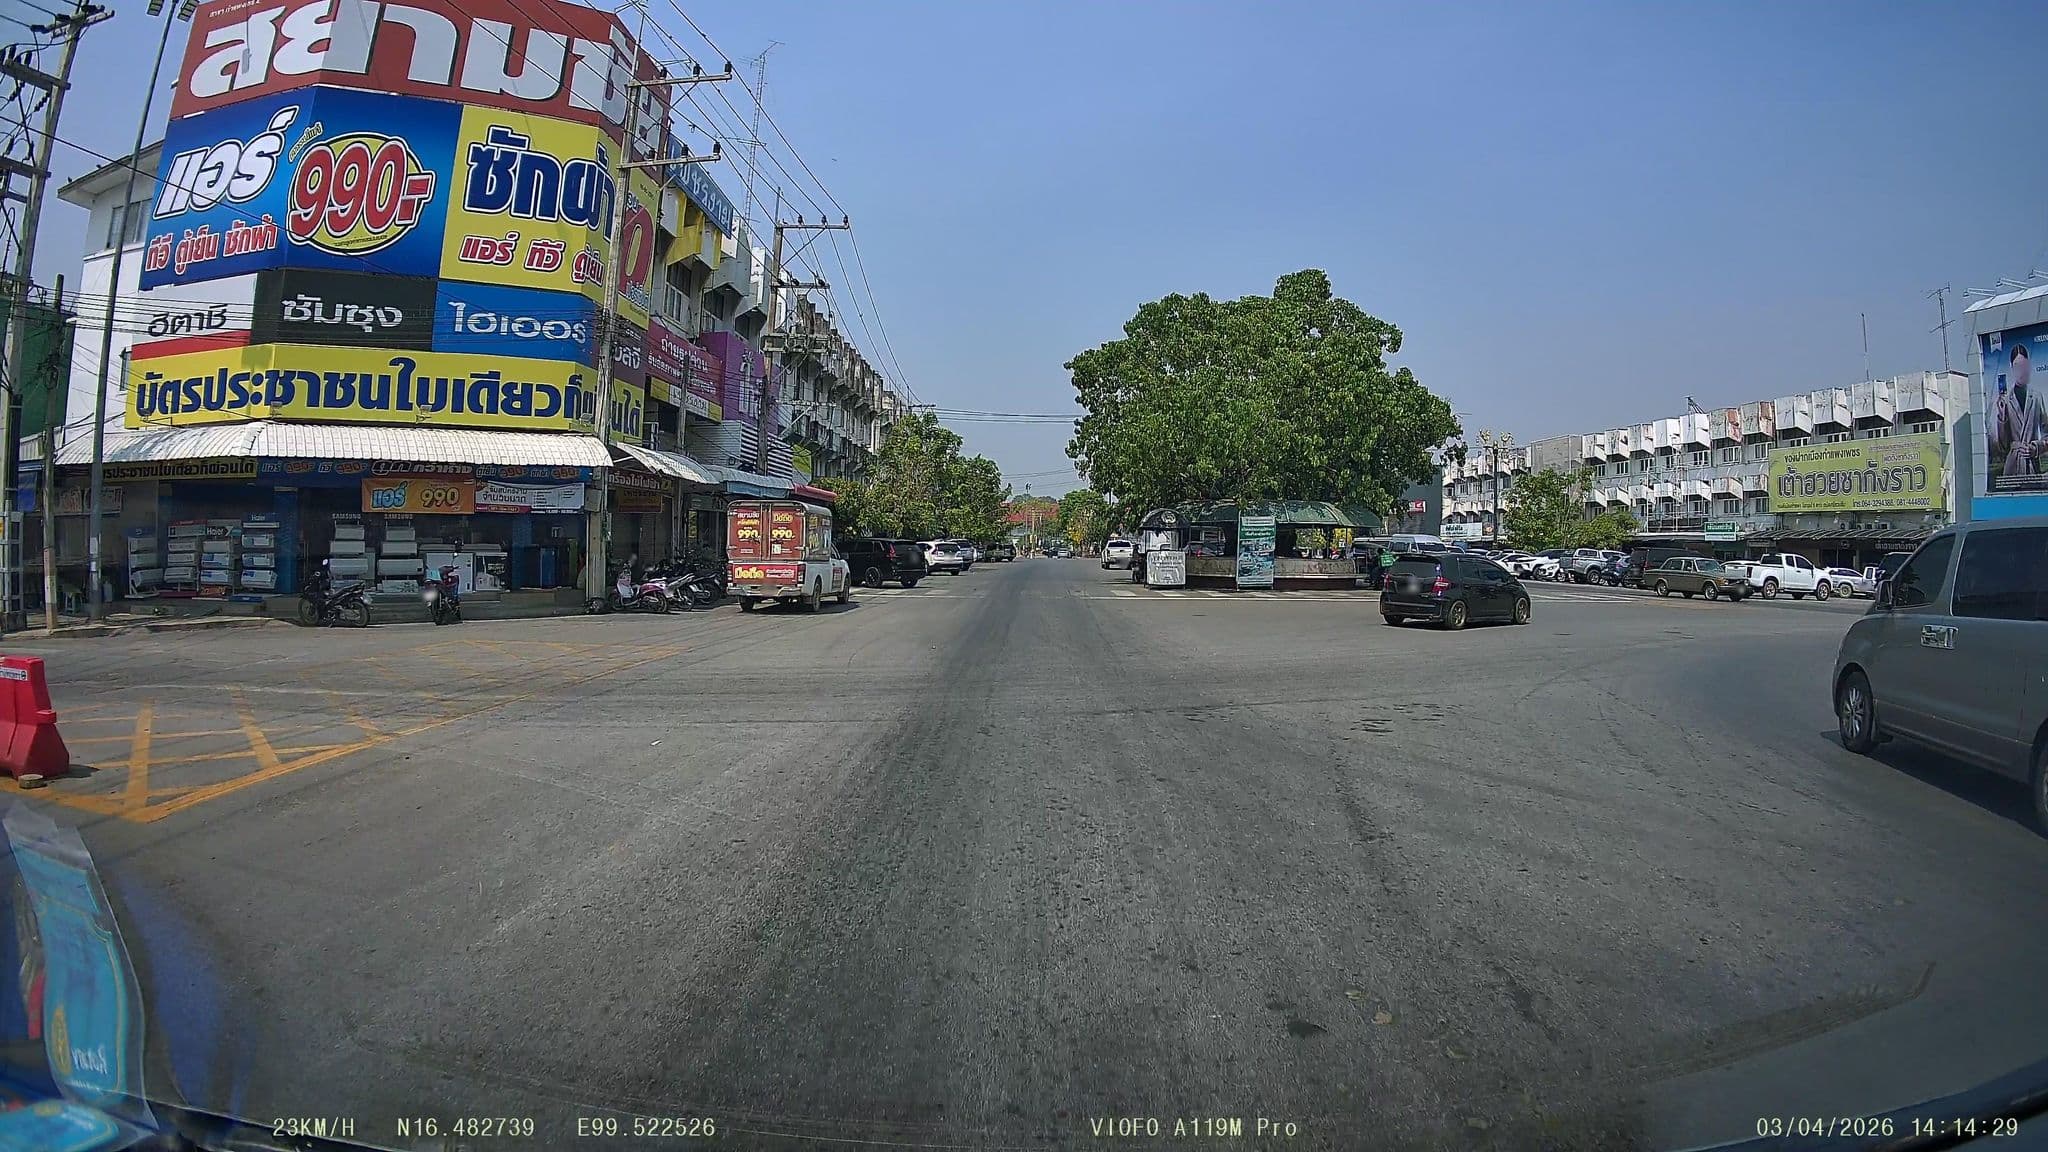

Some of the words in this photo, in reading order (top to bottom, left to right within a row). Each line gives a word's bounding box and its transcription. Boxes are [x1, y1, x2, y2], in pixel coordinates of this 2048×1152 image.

[153, 105, 299, 220] แอร์
[464, 125, 617, 243] ซักผ้า
[145, 234, 172, 272] ทีวี
[175, 225, 219, 274] ตู้เย็น
[224, 216, 278, 257] ซักผ้า
[458, 231, 519, 266] แอร์
[524, 239, 565, 271] ทีวี
[571, 243, 606, 288] ตู้เย็น
[281, 293, 403, 333] ซัมซุง
[448, 302, 588, 344] ไฮเออร์
[136, 356, 641, 437] บัตรประชาชนใบเดียวก็ผ่นได้
[371, 480, 409, 510] แอร์
[608, 470, 660, 489] ครื่องใช้ไฟฟ้า
[1777, 460, 1928, 497] เต้าฮวยชากังราว
